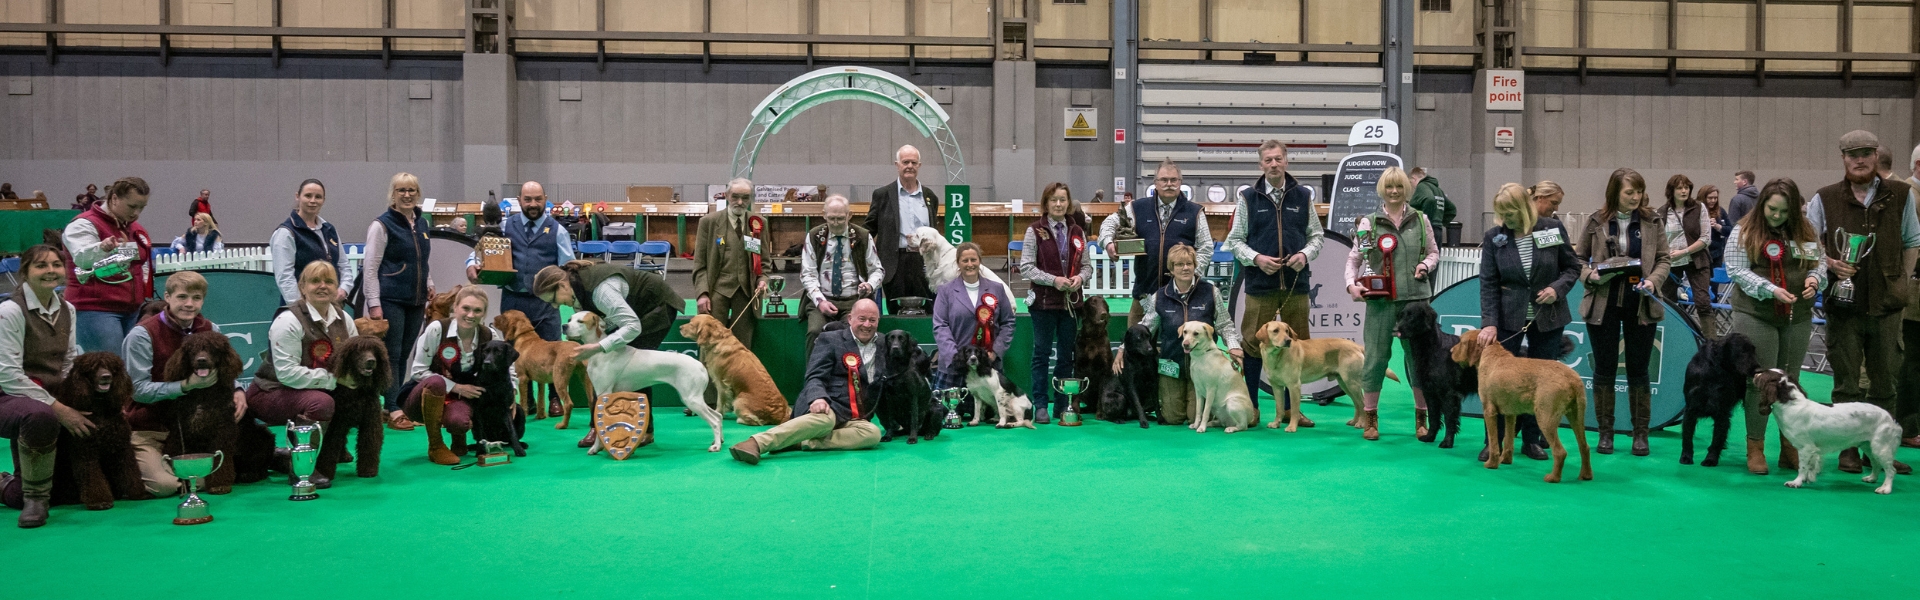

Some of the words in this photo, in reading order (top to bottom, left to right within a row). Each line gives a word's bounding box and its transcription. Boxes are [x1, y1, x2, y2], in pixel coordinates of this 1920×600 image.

[1493, 76, 1517, 87] Fire
[1489, 91, 1522, 103] point
[1364, 125, 1384, 138] 25
[1308, 313, 1361, 327] NER'S
